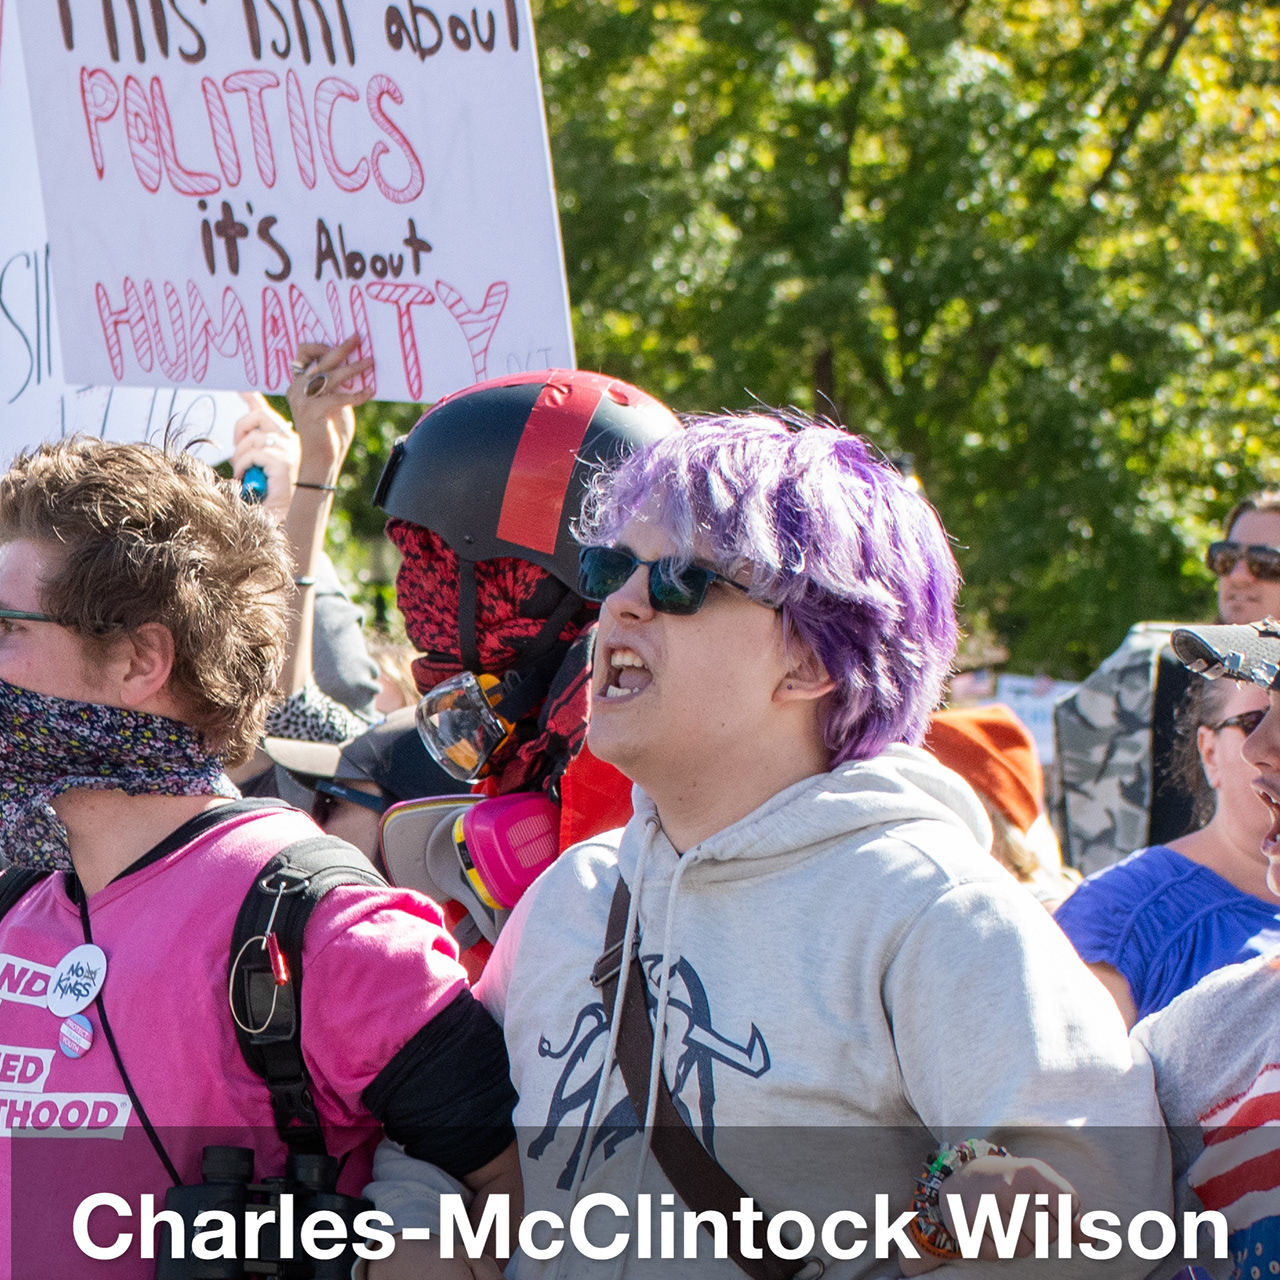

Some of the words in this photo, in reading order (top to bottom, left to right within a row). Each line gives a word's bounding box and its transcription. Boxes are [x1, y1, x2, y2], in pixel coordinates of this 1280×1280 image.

[244, 0, 356, 66] isnt
[79, 66, 425, 203] POLITICS
[197, 200, 291, 281] it's
[314, 219, 432, 280] About
[96, 276, 509, 400] HUMANITY
[67, 961, 85, 978] NO
